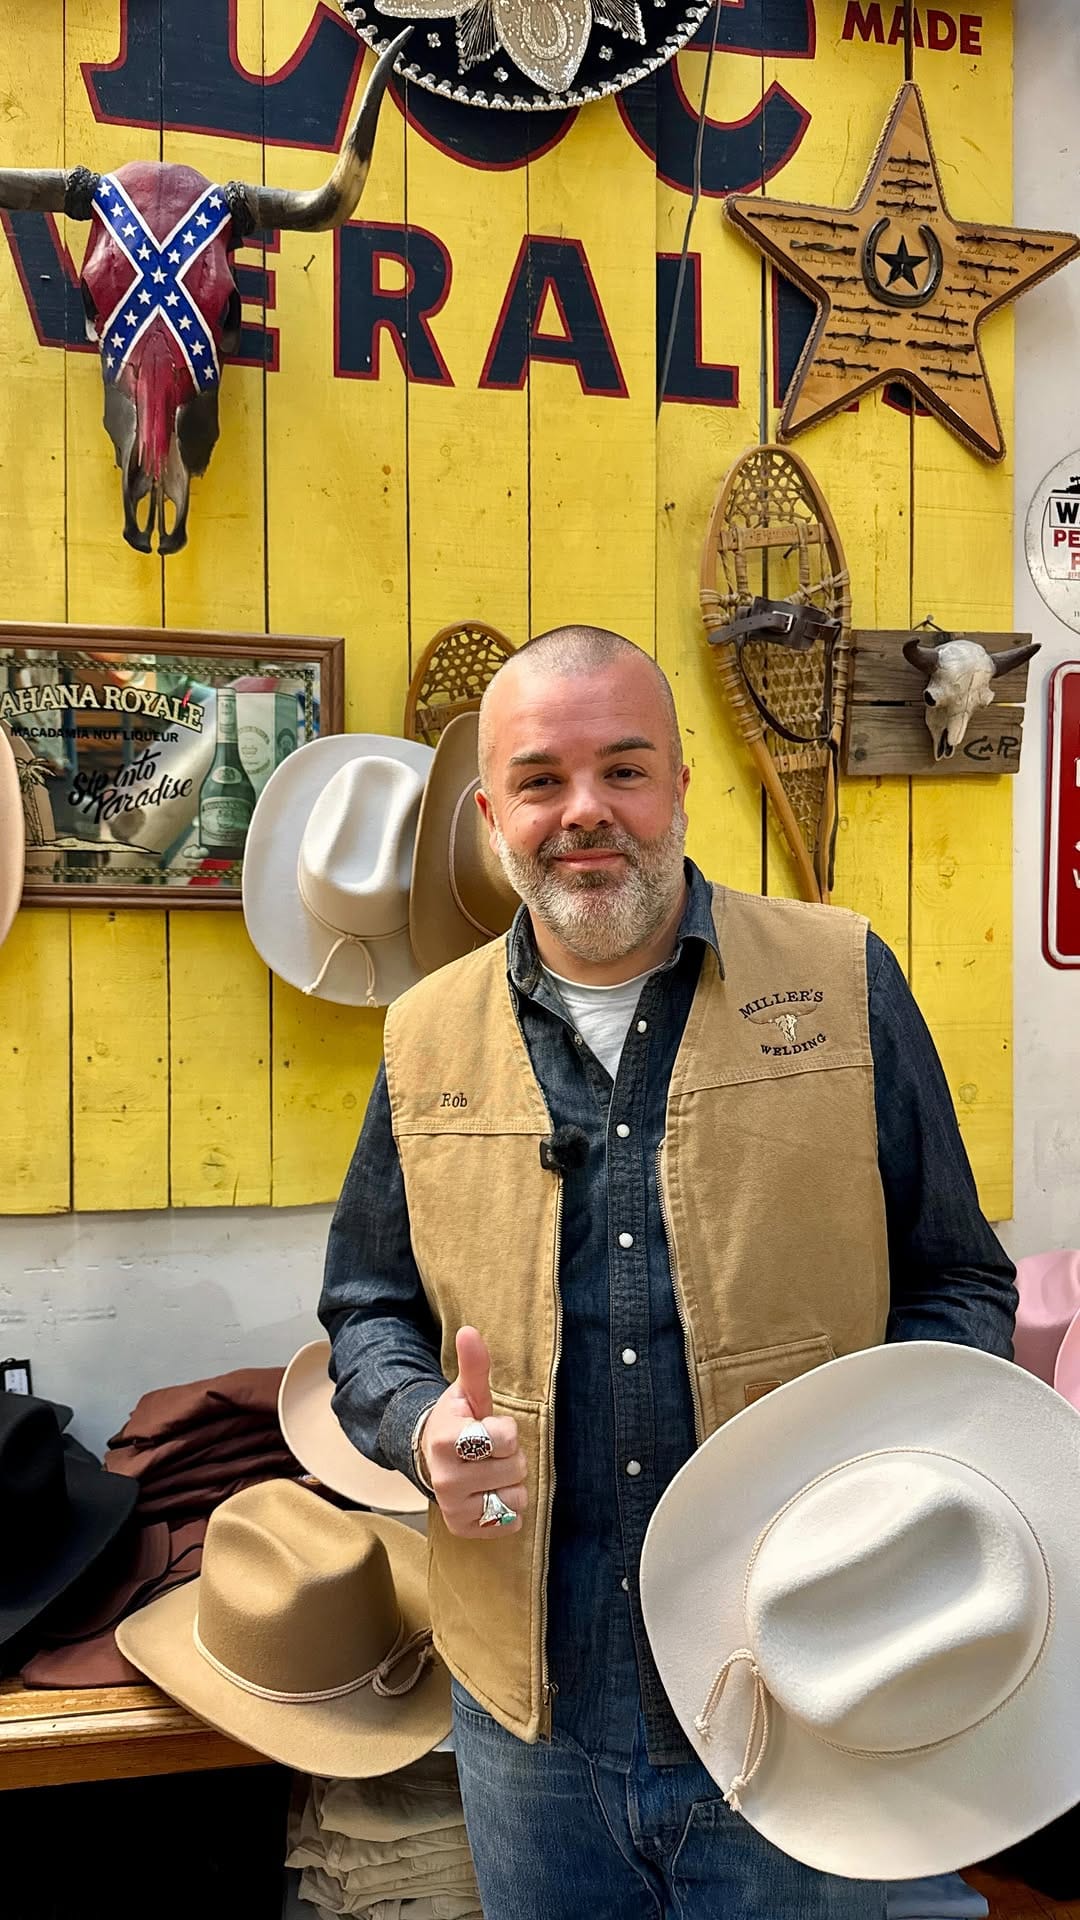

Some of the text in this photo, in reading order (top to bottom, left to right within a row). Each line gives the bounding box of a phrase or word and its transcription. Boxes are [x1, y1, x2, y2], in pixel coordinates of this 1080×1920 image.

[841, 0, 983, 56] MADE
[1056, 501, 1080, 525] W
[103, 684, 205, 734] ROYALE
[10, 727, 179, 743] MACADAMIA NUT LIQUEUR
[68, 770, 109, 806] Sip
[82, 774, 193, 825] Paradise
[739, 988, 824, 1019] MILLER'S
[761, 1033, 826, 1056] WELDING
[440, 1092, 468, 1108] Rob
